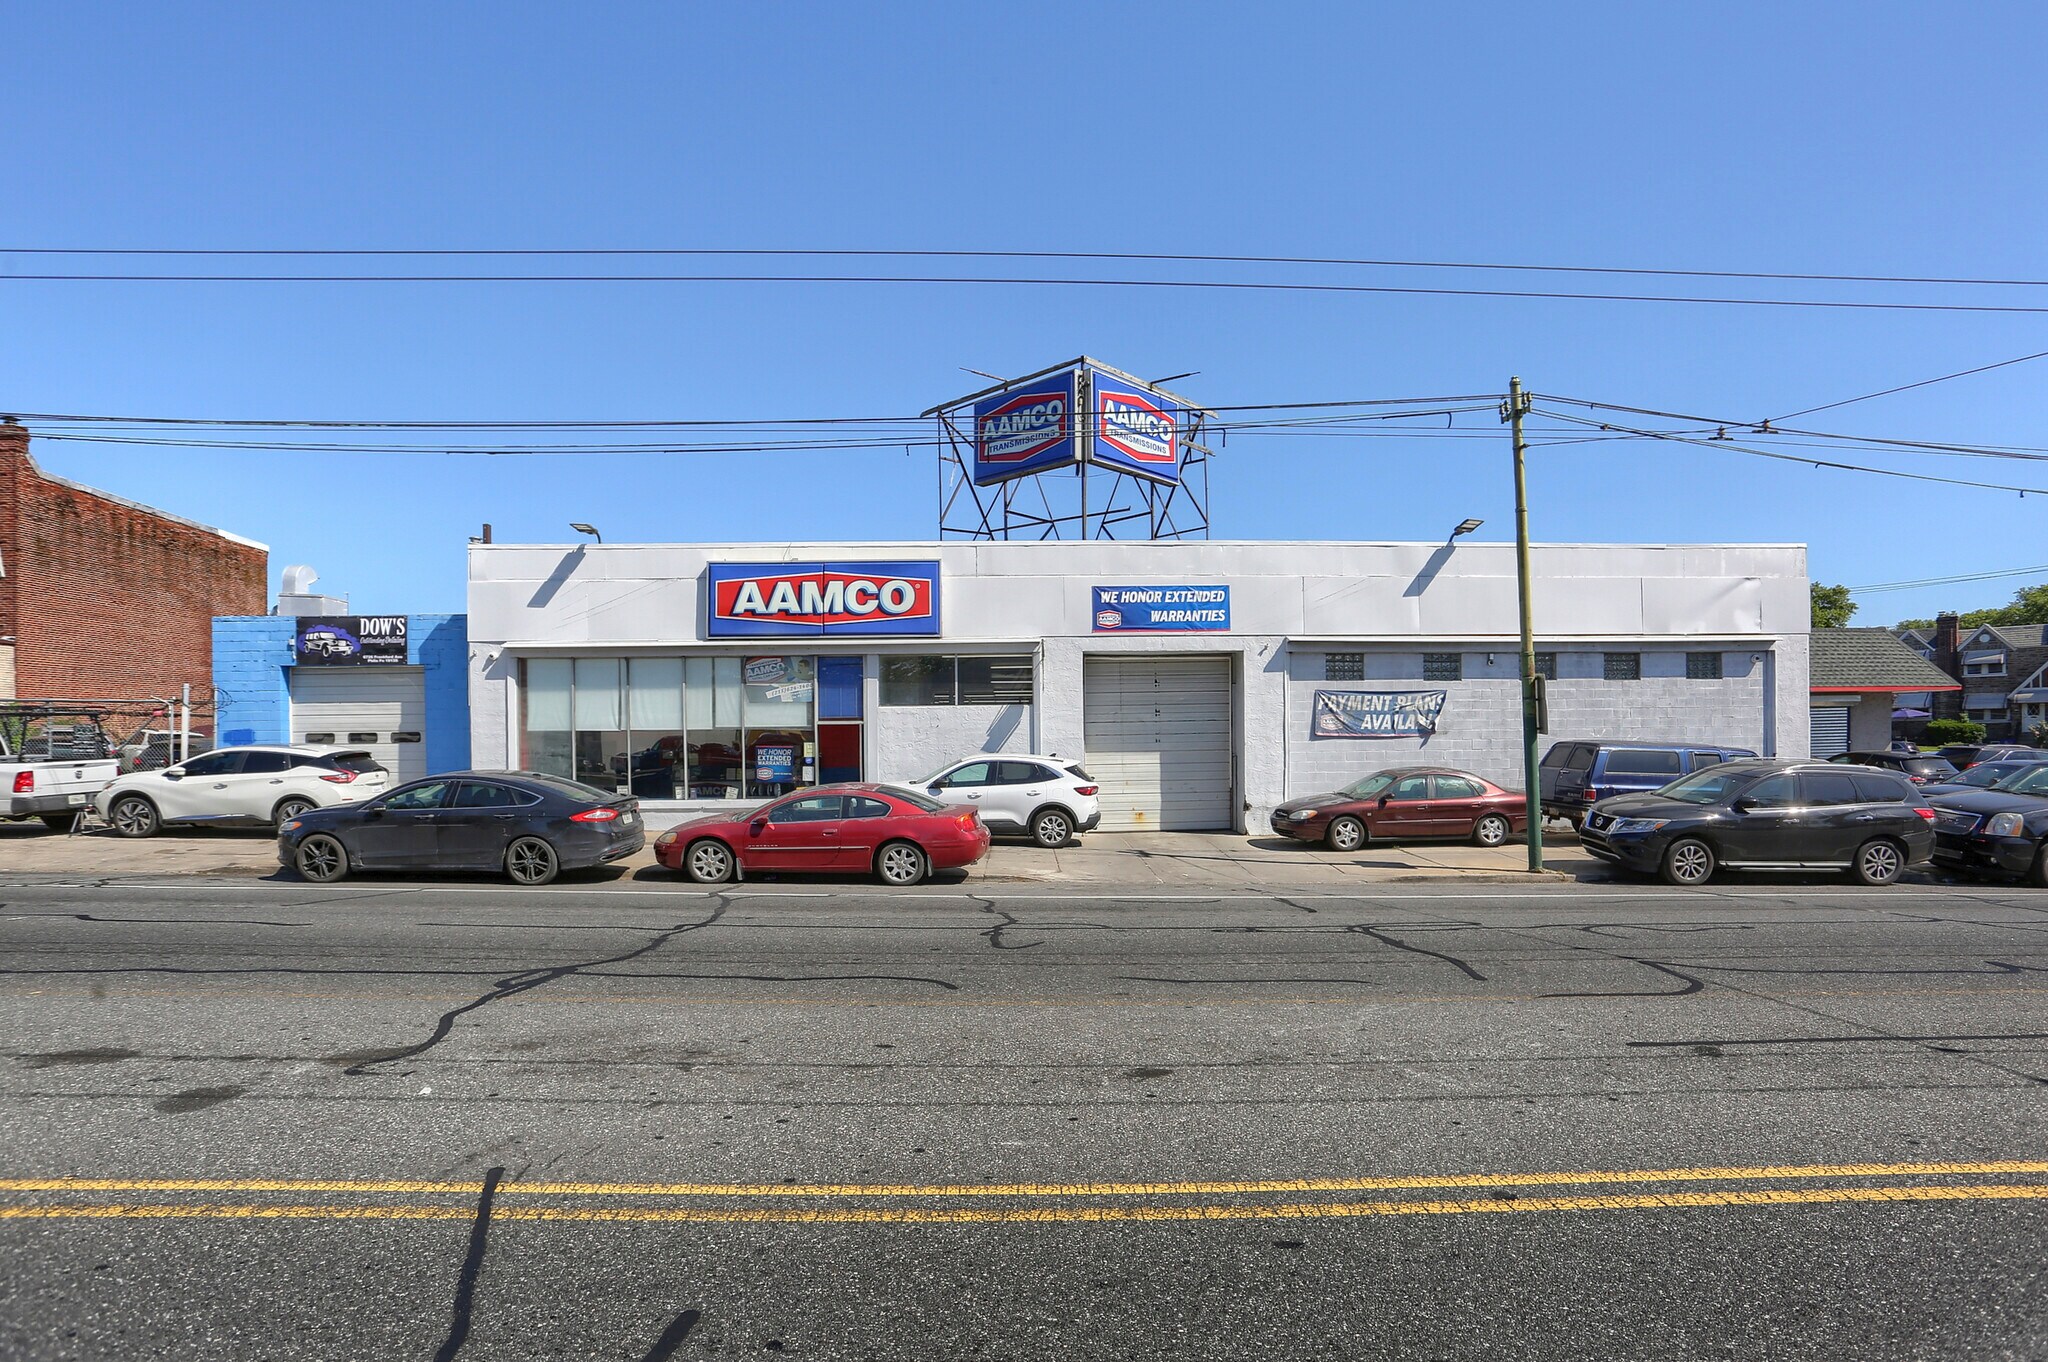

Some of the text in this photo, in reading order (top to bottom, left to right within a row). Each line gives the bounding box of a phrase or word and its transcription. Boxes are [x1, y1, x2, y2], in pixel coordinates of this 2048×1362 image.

[983, 400, 1063, 440] AAMCO
[1103, 399, 1173, 441] AAMCO
[989, 429, 1055, 453] TRANSMISSIONS
[1111, 429, 1167, 454] TRANSMISSIONS
[731, 579, 916, 616] AAMCO
[1100, 590, 1225, 603] WE HONOR EXTENDED
[360, 618, 405, 636] DOW'S
[1150, 609, 1226, 622] WARRANTIES
[746, 662, 785, 677] AAMCO
